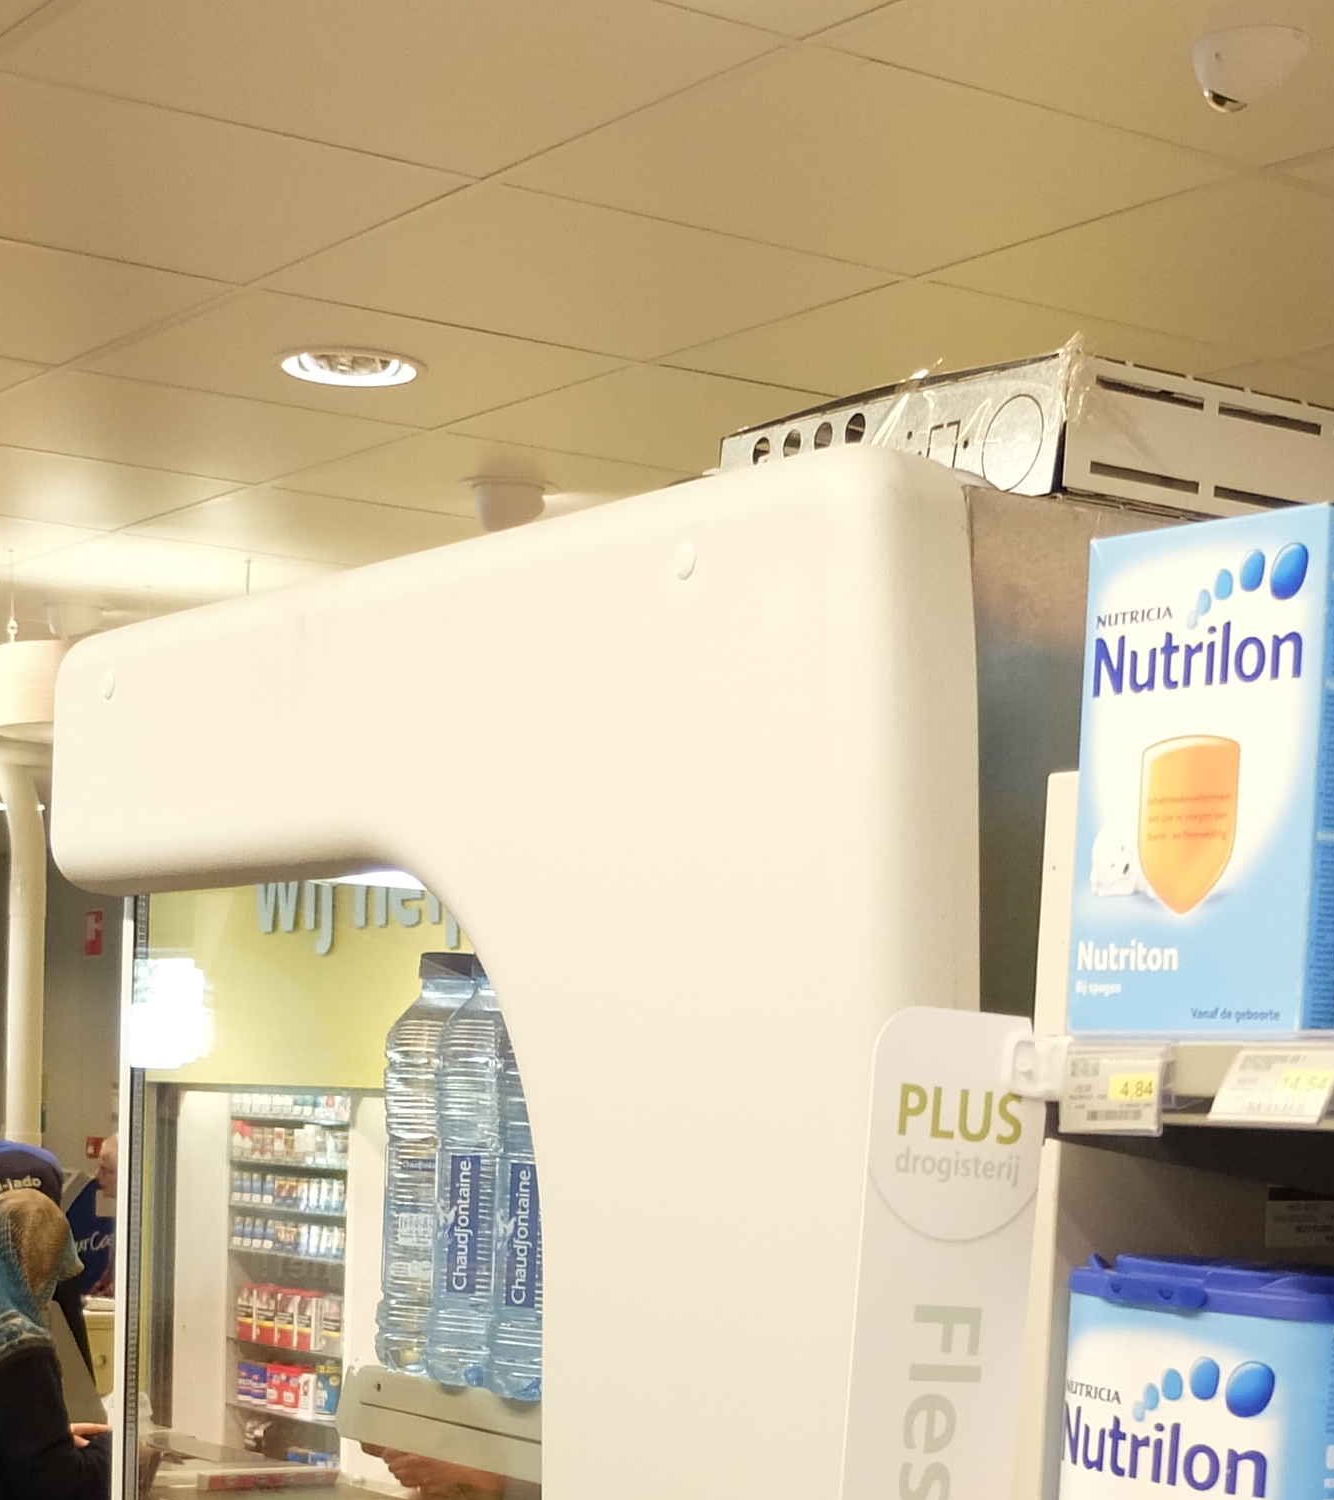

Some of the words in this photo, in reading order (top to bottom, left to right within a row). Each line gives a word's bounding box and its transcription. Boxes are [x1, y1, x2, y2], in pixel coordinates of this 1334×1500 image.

[1096, 606, 1172, 629] NUTRICIA
[1092, 621, 1302, 698] Nutrilon
[1076, 940, 1178, 972] Nutriton
[898, 1083, 1022, 1145] PLUS
[894, 1146, 1021, 1188] drogisterij
[453, 1156, 473, 1291] Chaudfontaine
[512, 1166, 532, 1305] Chaudfontaine
[1062, 1401, 1267, 1499] Nutrilon
